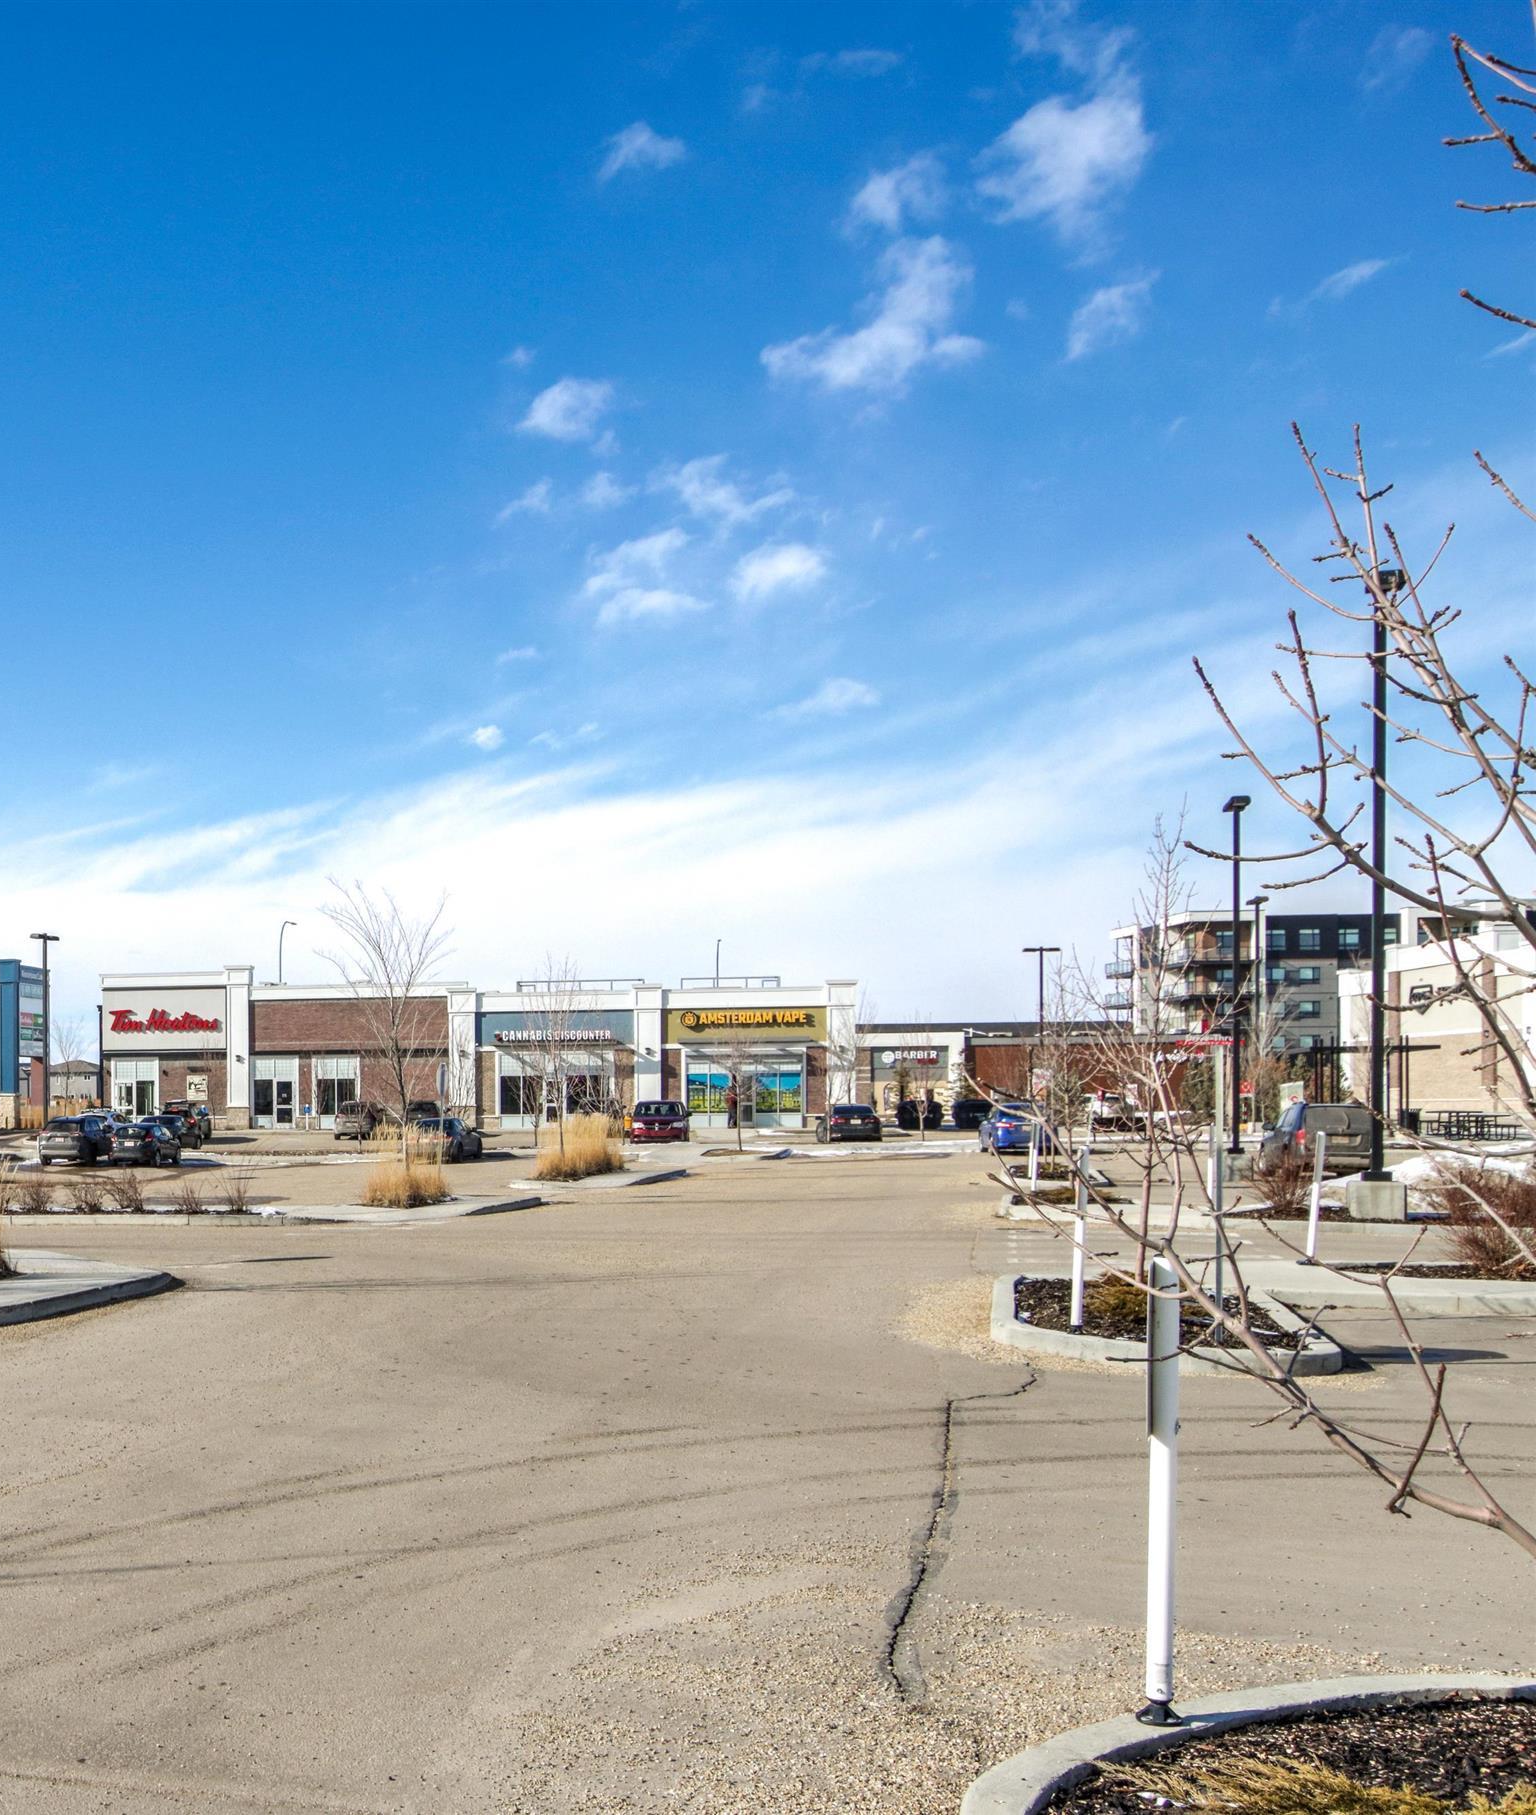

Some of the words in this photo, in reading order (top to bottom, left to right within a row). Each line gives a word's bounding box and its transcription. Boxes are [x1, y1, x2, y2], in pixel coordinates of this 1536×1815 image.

[109, 1010, 143, 1031] Tim
[145, 1008, 218, 1031] Hortons
[699, 1012, 772, 1024] AMSTERDAM
[776, 1011, 807, 1023] VAPE
[502, 1030, 552, 1041] CANNABIS
[555, 1030, 611, 1040] DISCOUNTER
[895, 1051, 937, 1059] BARBER
